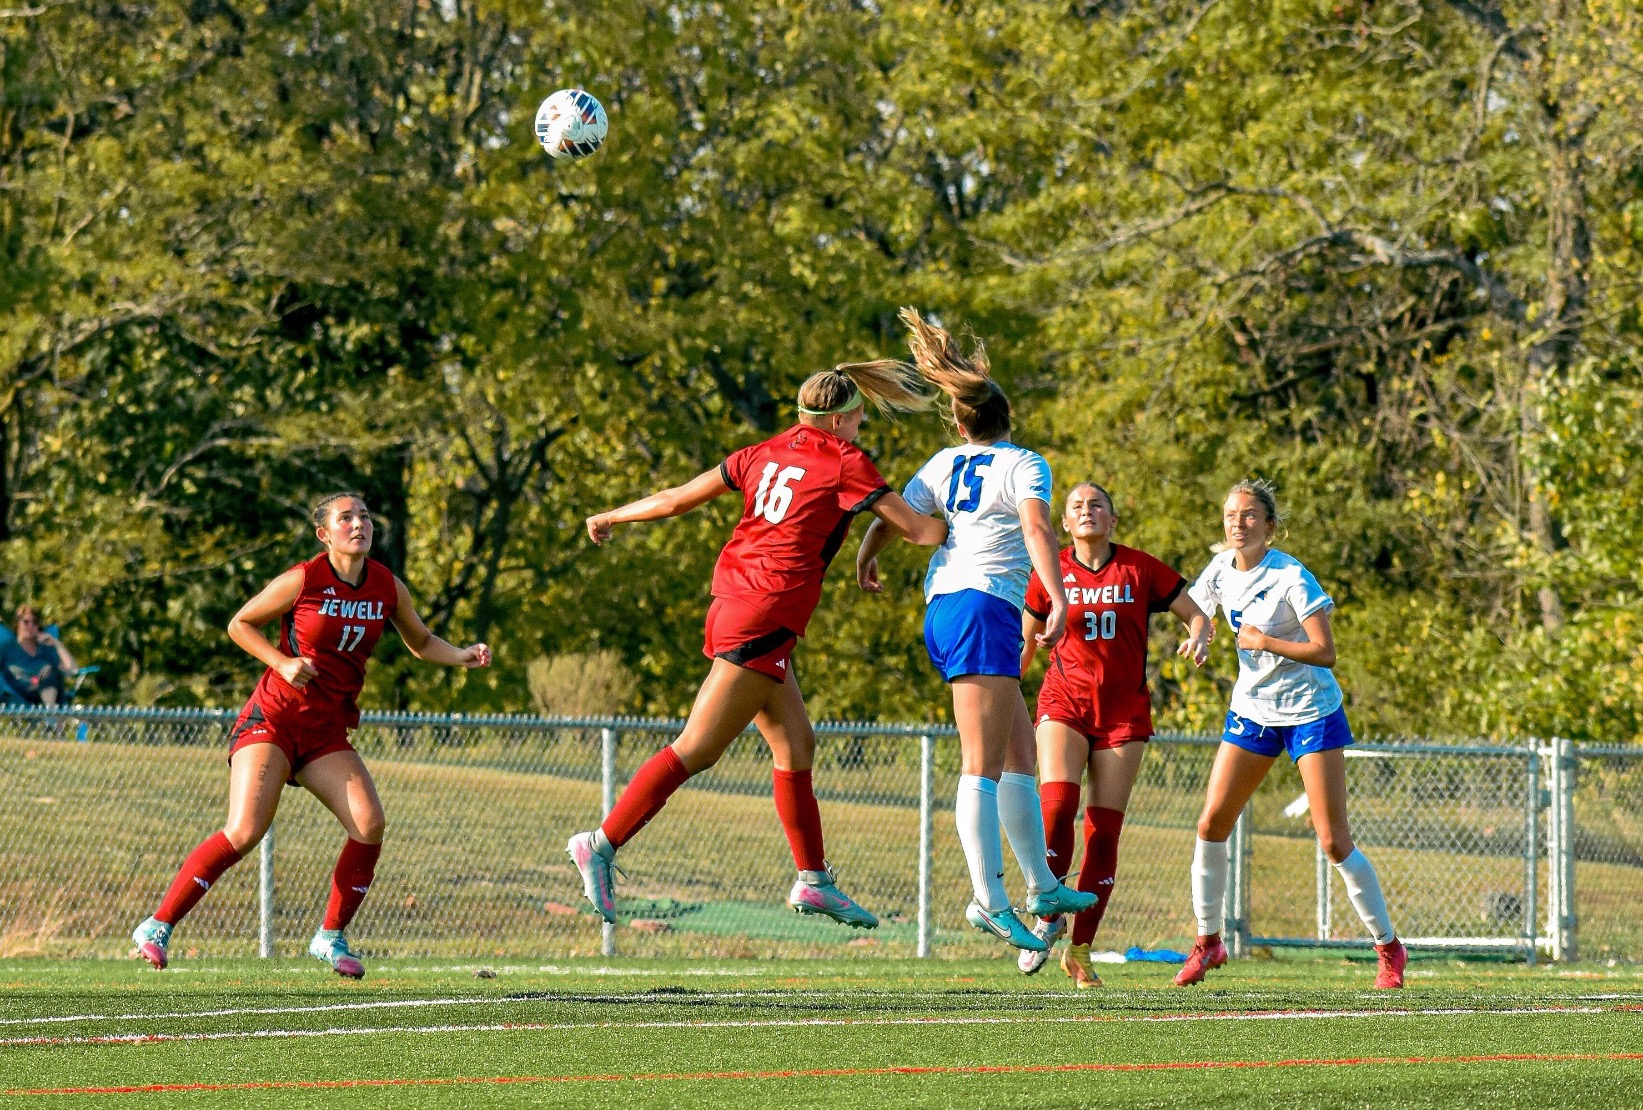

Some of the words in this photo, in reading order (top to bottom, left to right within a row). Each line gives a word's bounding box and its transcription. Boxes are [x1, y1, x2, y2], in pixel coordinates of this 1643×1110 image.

[754, 461, 807, 525] 16
[946, 454, 995, 513] 15
[318, 599, 383, 619] JEWELL
[337, 625, 366, 652] 17
[1085, 611, 1116, 641] 30
